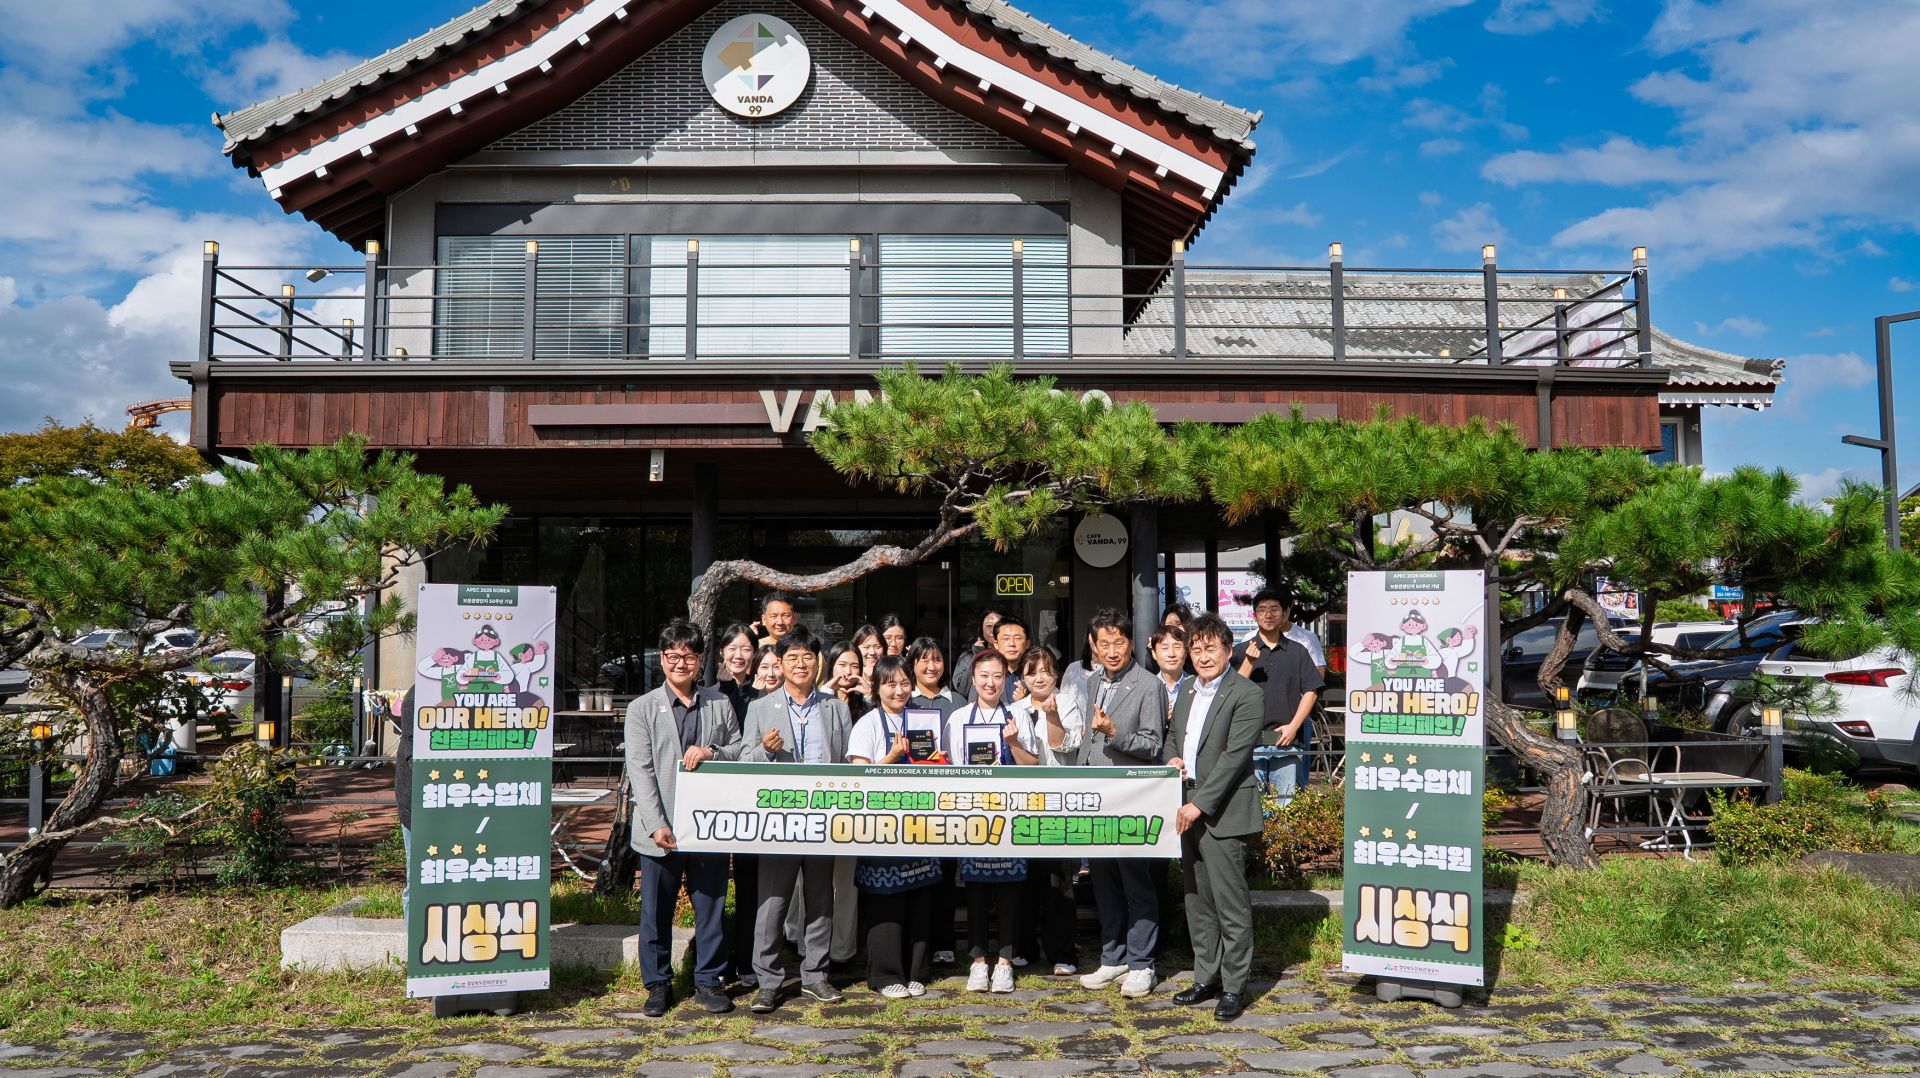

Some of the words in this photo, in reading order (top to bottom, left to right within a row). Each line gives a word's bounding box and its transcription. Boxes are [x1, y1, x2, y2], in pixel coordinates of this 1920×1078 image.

[737, 96, 774, 104] VANDA
[748, 105, 763, 115] 99
[1118, 537, 1127, 545] 99
[998, 576, 1033, 593] OPEN
[1382, 678, 1415, 692] YOU
[1415, 678, 1445, 692] ARE
[453, 693, 486, 707] YOU
[487, 693, 517, 707] ARE
[1350, 690, 1399, 714] OUR
[1402, 691, 1479, 716] HERO!
[418, 706, 469, 729] OUR
[473, 706, 550, 730] HERO!
[1361, 713, 1466, 737] 친절캠페인!
[430, 729, 538, 750] 친절캠페인!
[1354, 765, 1472, 796] 최우수업체
[422, 781, 542, 809] 최우수업체
[756, 788, 808, 809] 2025
[810, 789, 864, 810] APEC
[866, 791, 936, 811] 정상회의
[938, 792, 1007, 812] 성공적인
[1010, 792, 1062, 812] 개최를
[1065, 792, 1101, 812] 위한
[693, 810, 760, 841] YOU
[761, 812, 827, 843] ARE
[831, 813, 898, 845] OUR
[902, 814, 1006, 846] HERO!
[1011, 815, 1164, 846] 친절캠페인!
[1353, 839, 1472, 873] 최우수직원
[420, 855, 541, 885] 최우수직원
[1354, 883, 1471, 954] 시상식
[419, 899, 540, 966] 시상식
